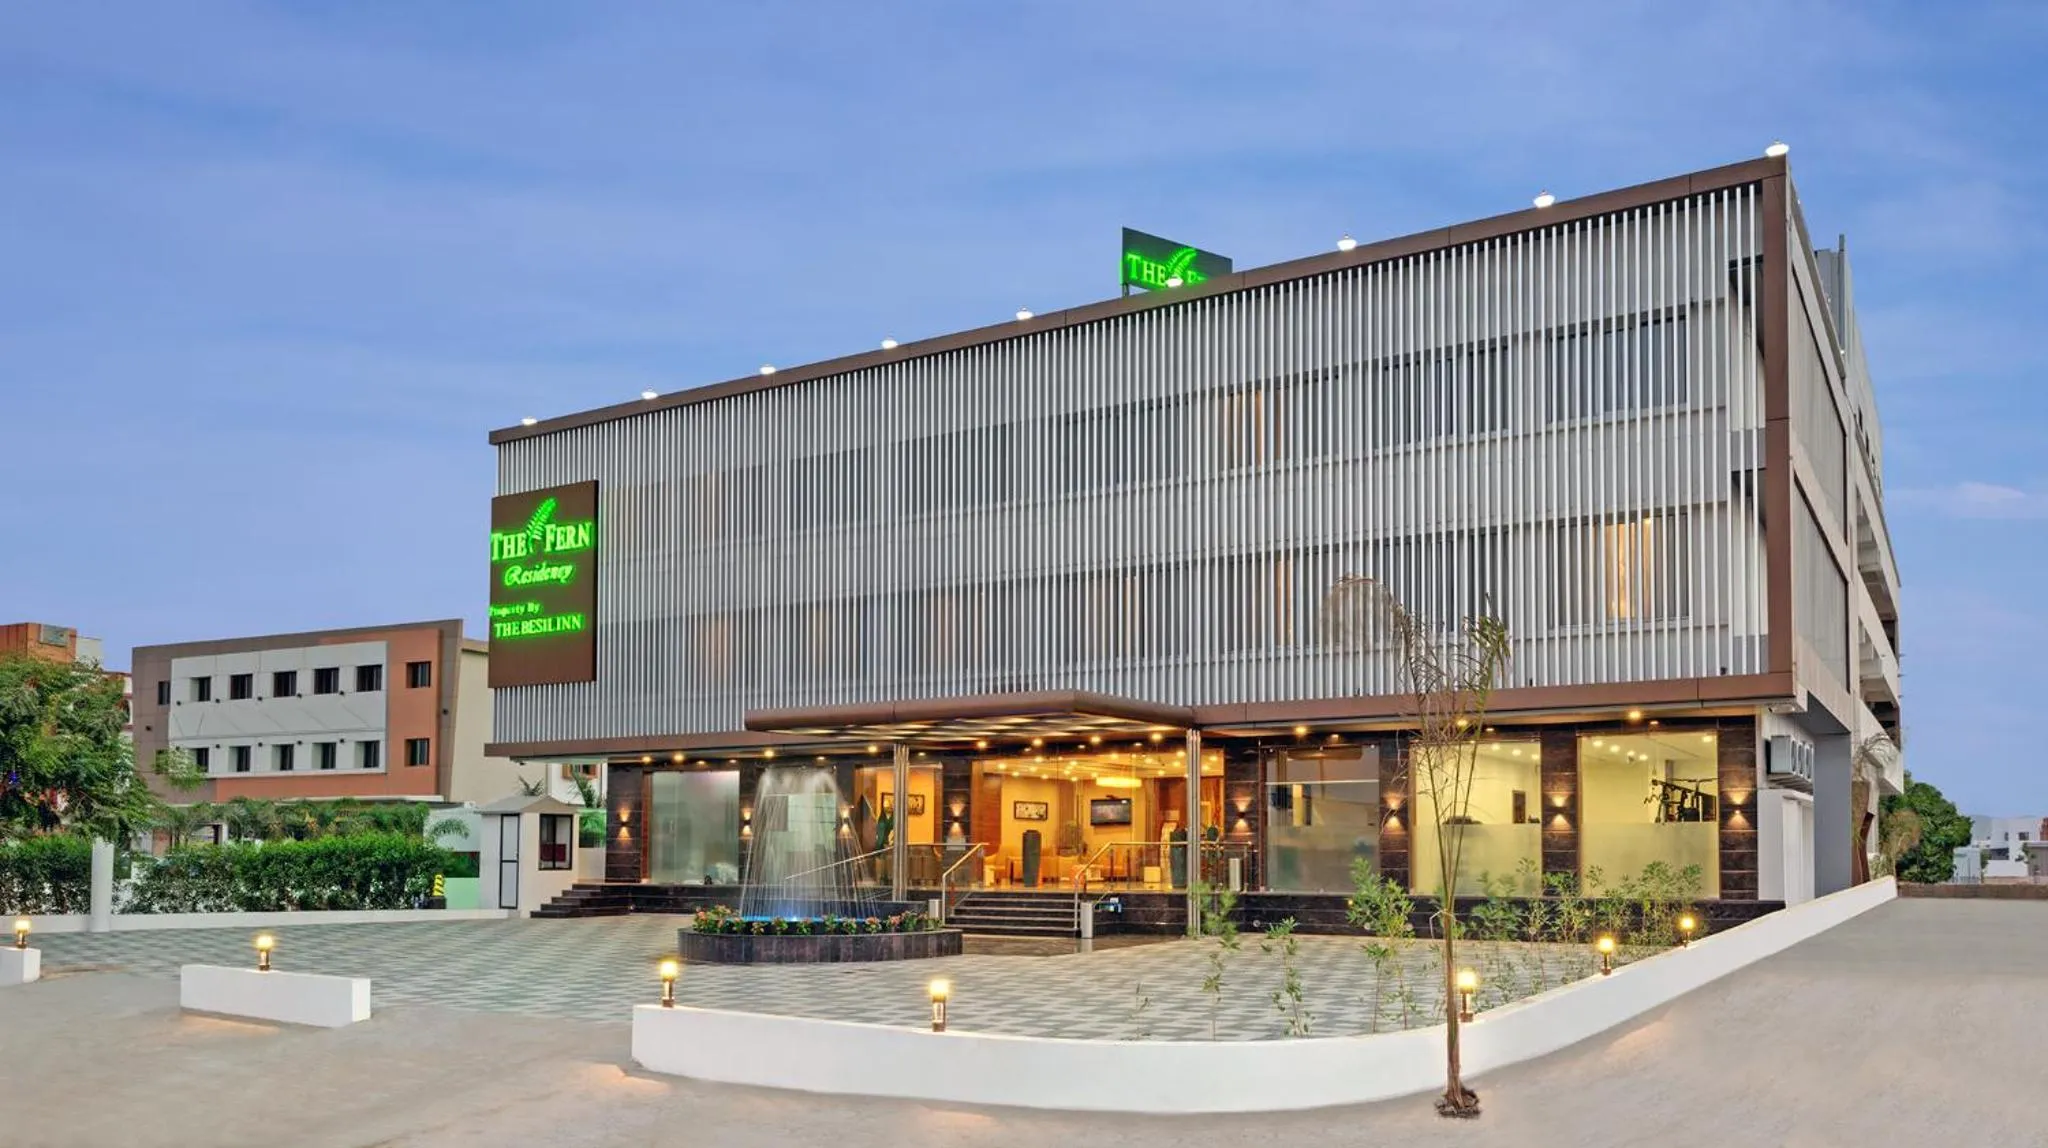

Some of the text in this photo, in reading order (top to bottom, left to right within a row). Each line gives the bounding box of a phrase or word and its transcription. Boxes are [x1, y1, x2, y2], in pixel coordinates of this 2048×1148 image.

[1127, 253, 1166, 286] THE
[491, 523, 592, 561] THE FERN
[504, 562, 573, 586] Residency
